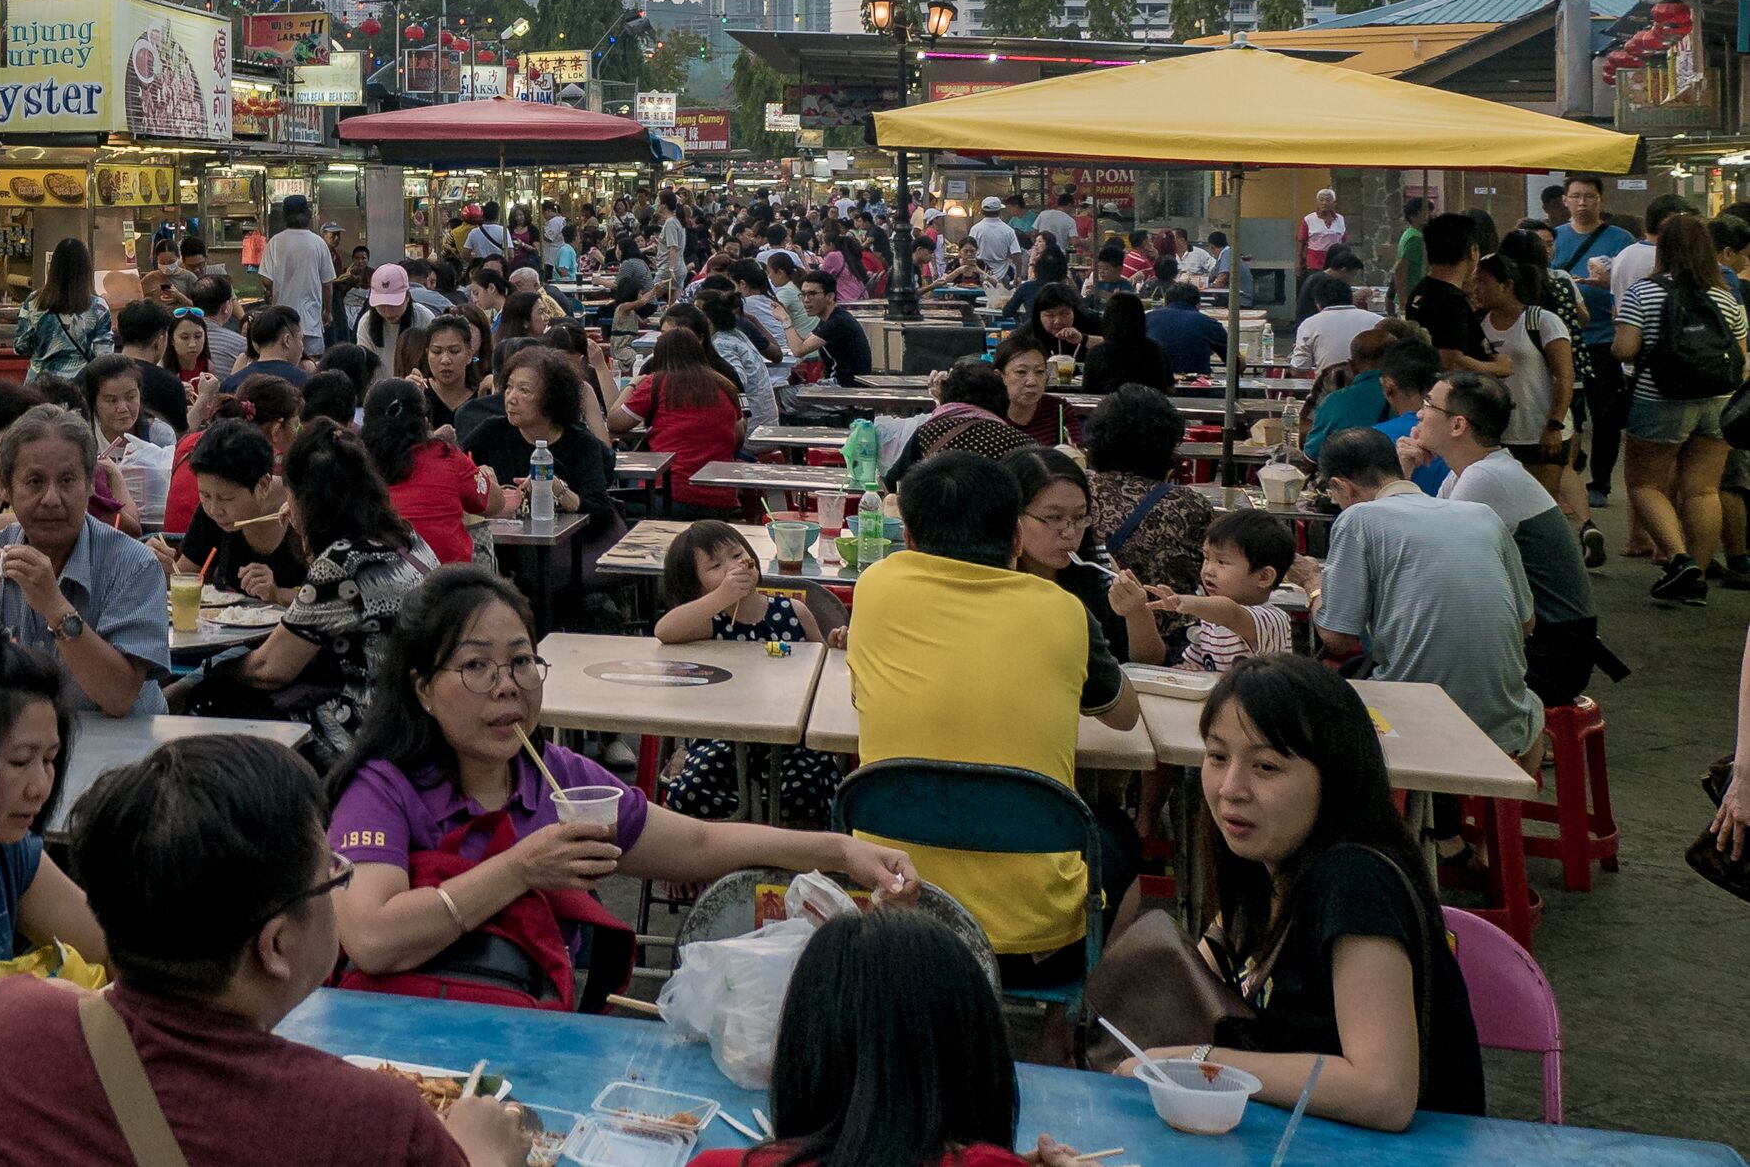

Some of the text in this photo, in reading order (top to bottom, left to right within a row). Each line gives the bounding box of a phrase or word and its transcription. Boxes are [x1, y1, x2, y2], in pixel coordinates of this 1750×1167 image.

[277, 32, 309, 42] LAKSA
[567, 72, 585, 80] LOK
[466, 84, 500, 95] LAKSA
[311, 92, 325, 101] BEAN
[329, 92, 343, 101] BEAN
